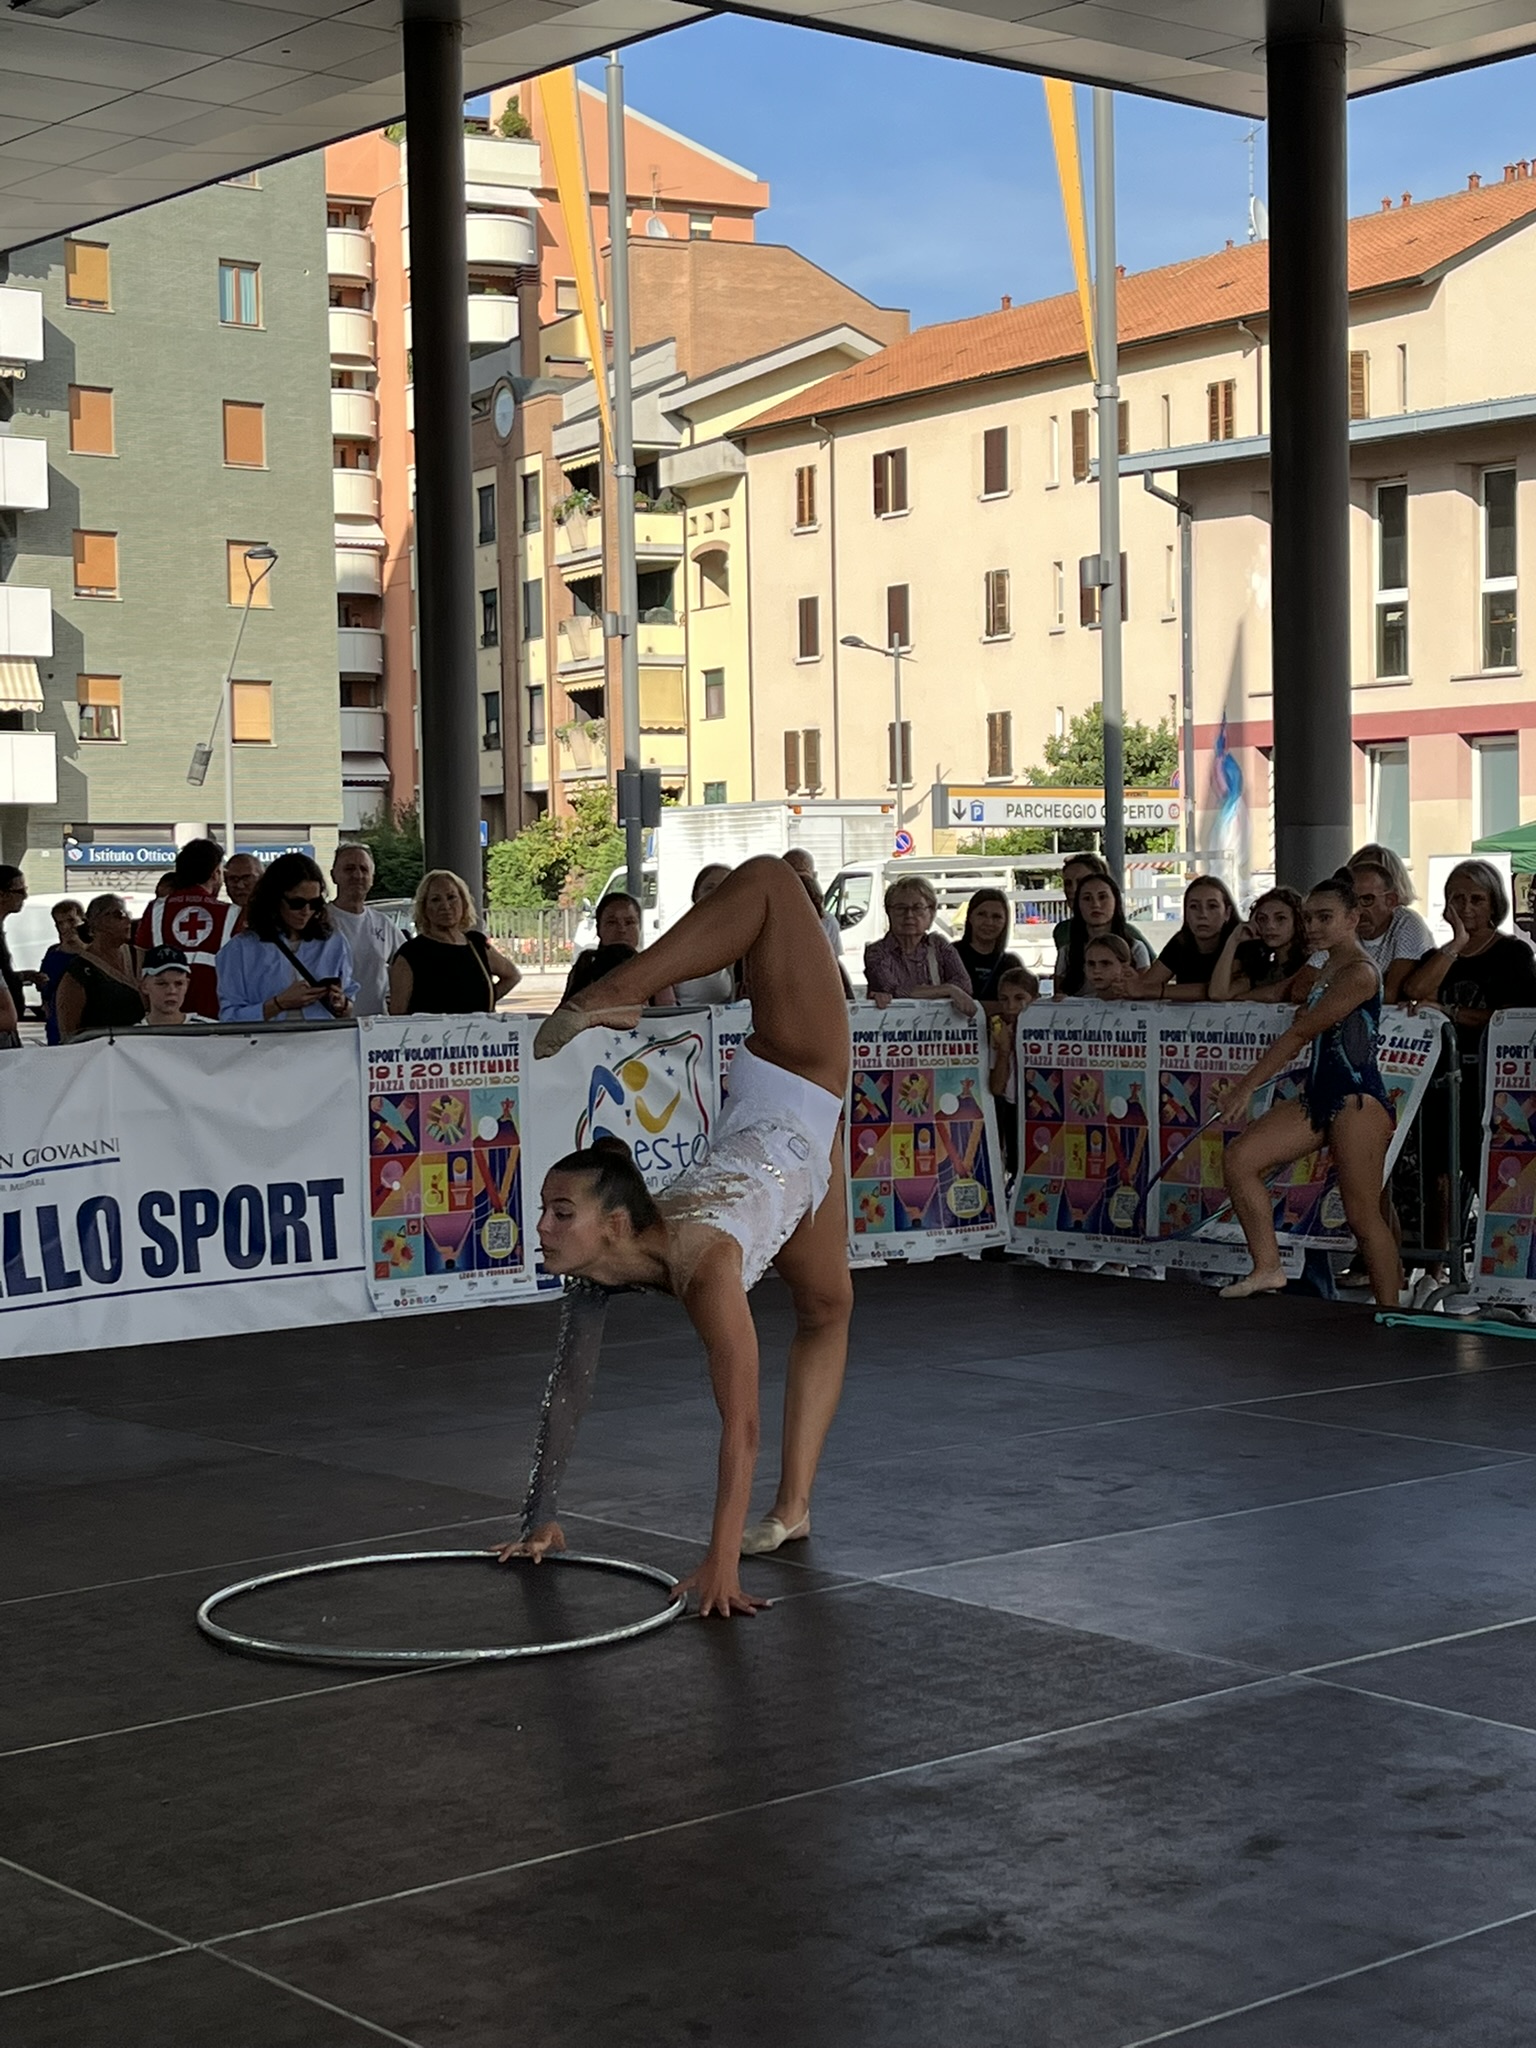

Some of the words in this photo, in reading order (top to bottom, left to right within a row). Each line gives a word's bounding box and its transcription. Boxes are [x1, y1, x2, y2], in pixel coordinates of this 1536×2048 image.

[1006, 804, 1096, 819] PARCHEGGIO
[1100, 804, 1164, 819] CPERTO
[89, 848, 134, 862] Istituto
[137, 848, 176, 862] Ottico
[853, 1031, 879, 1043] SPORT
[882, 1030, 942, 1042] VOLONTARIATO
[945, 1029, 978, 1041] SALUTE
[1022, 1029, 1050, 1041] SPORT
[1116, 1030, 1147, 1043] SALUTE
[1159, 1030, 1187, 1043] SPORT
[1190, 1031, 1256, 1045] VOLONTARIATO
[876, 1045, 882, 1057] E
[887, 1044, 913, 1057] 20
[918, 1043, 979, 1056] SETTEMBRE
[1048, 1043, 1053, 1055] E
[1057, 1043, 1083, 1056] 20
[1088, 1044, 1147, 1058] SETTEMBRE
[1184, 1045, 1190, 1057] E
[1195, 1045, 1222, 1058] 20
[1389, 1036, 1433, 1053] SALUTE
[369, 1049, 401, 1063] SPORT
[404, 1046, 479, 1062] VOLONTARIATO
[482, 1043, 520, 1058] SALUTE
[1379, 1049, 1428, 1067] EMBRE
[1496, 1045, 1530, 1059] SPORT
[397, 1064, 404, 1079] E
[410, 1063, 443, 1078] 20
[450, 1059, 520, 1075] SETTEMBRE
[853, 1058, 882, 1069] PIAZZA
[1524, 1061, 1531, 1075] E
[369, 1080, 405, 1093] PIAZZA
[1495, 1076, 1531, 1089] PIAZZA
[22, 1138, 120, 1167] GIOVANNI
[634, 1132, 710, 1172] esto
[0, 1195, 122, 1297] LLO
[138, 1178, 344, 1279] SPORT
